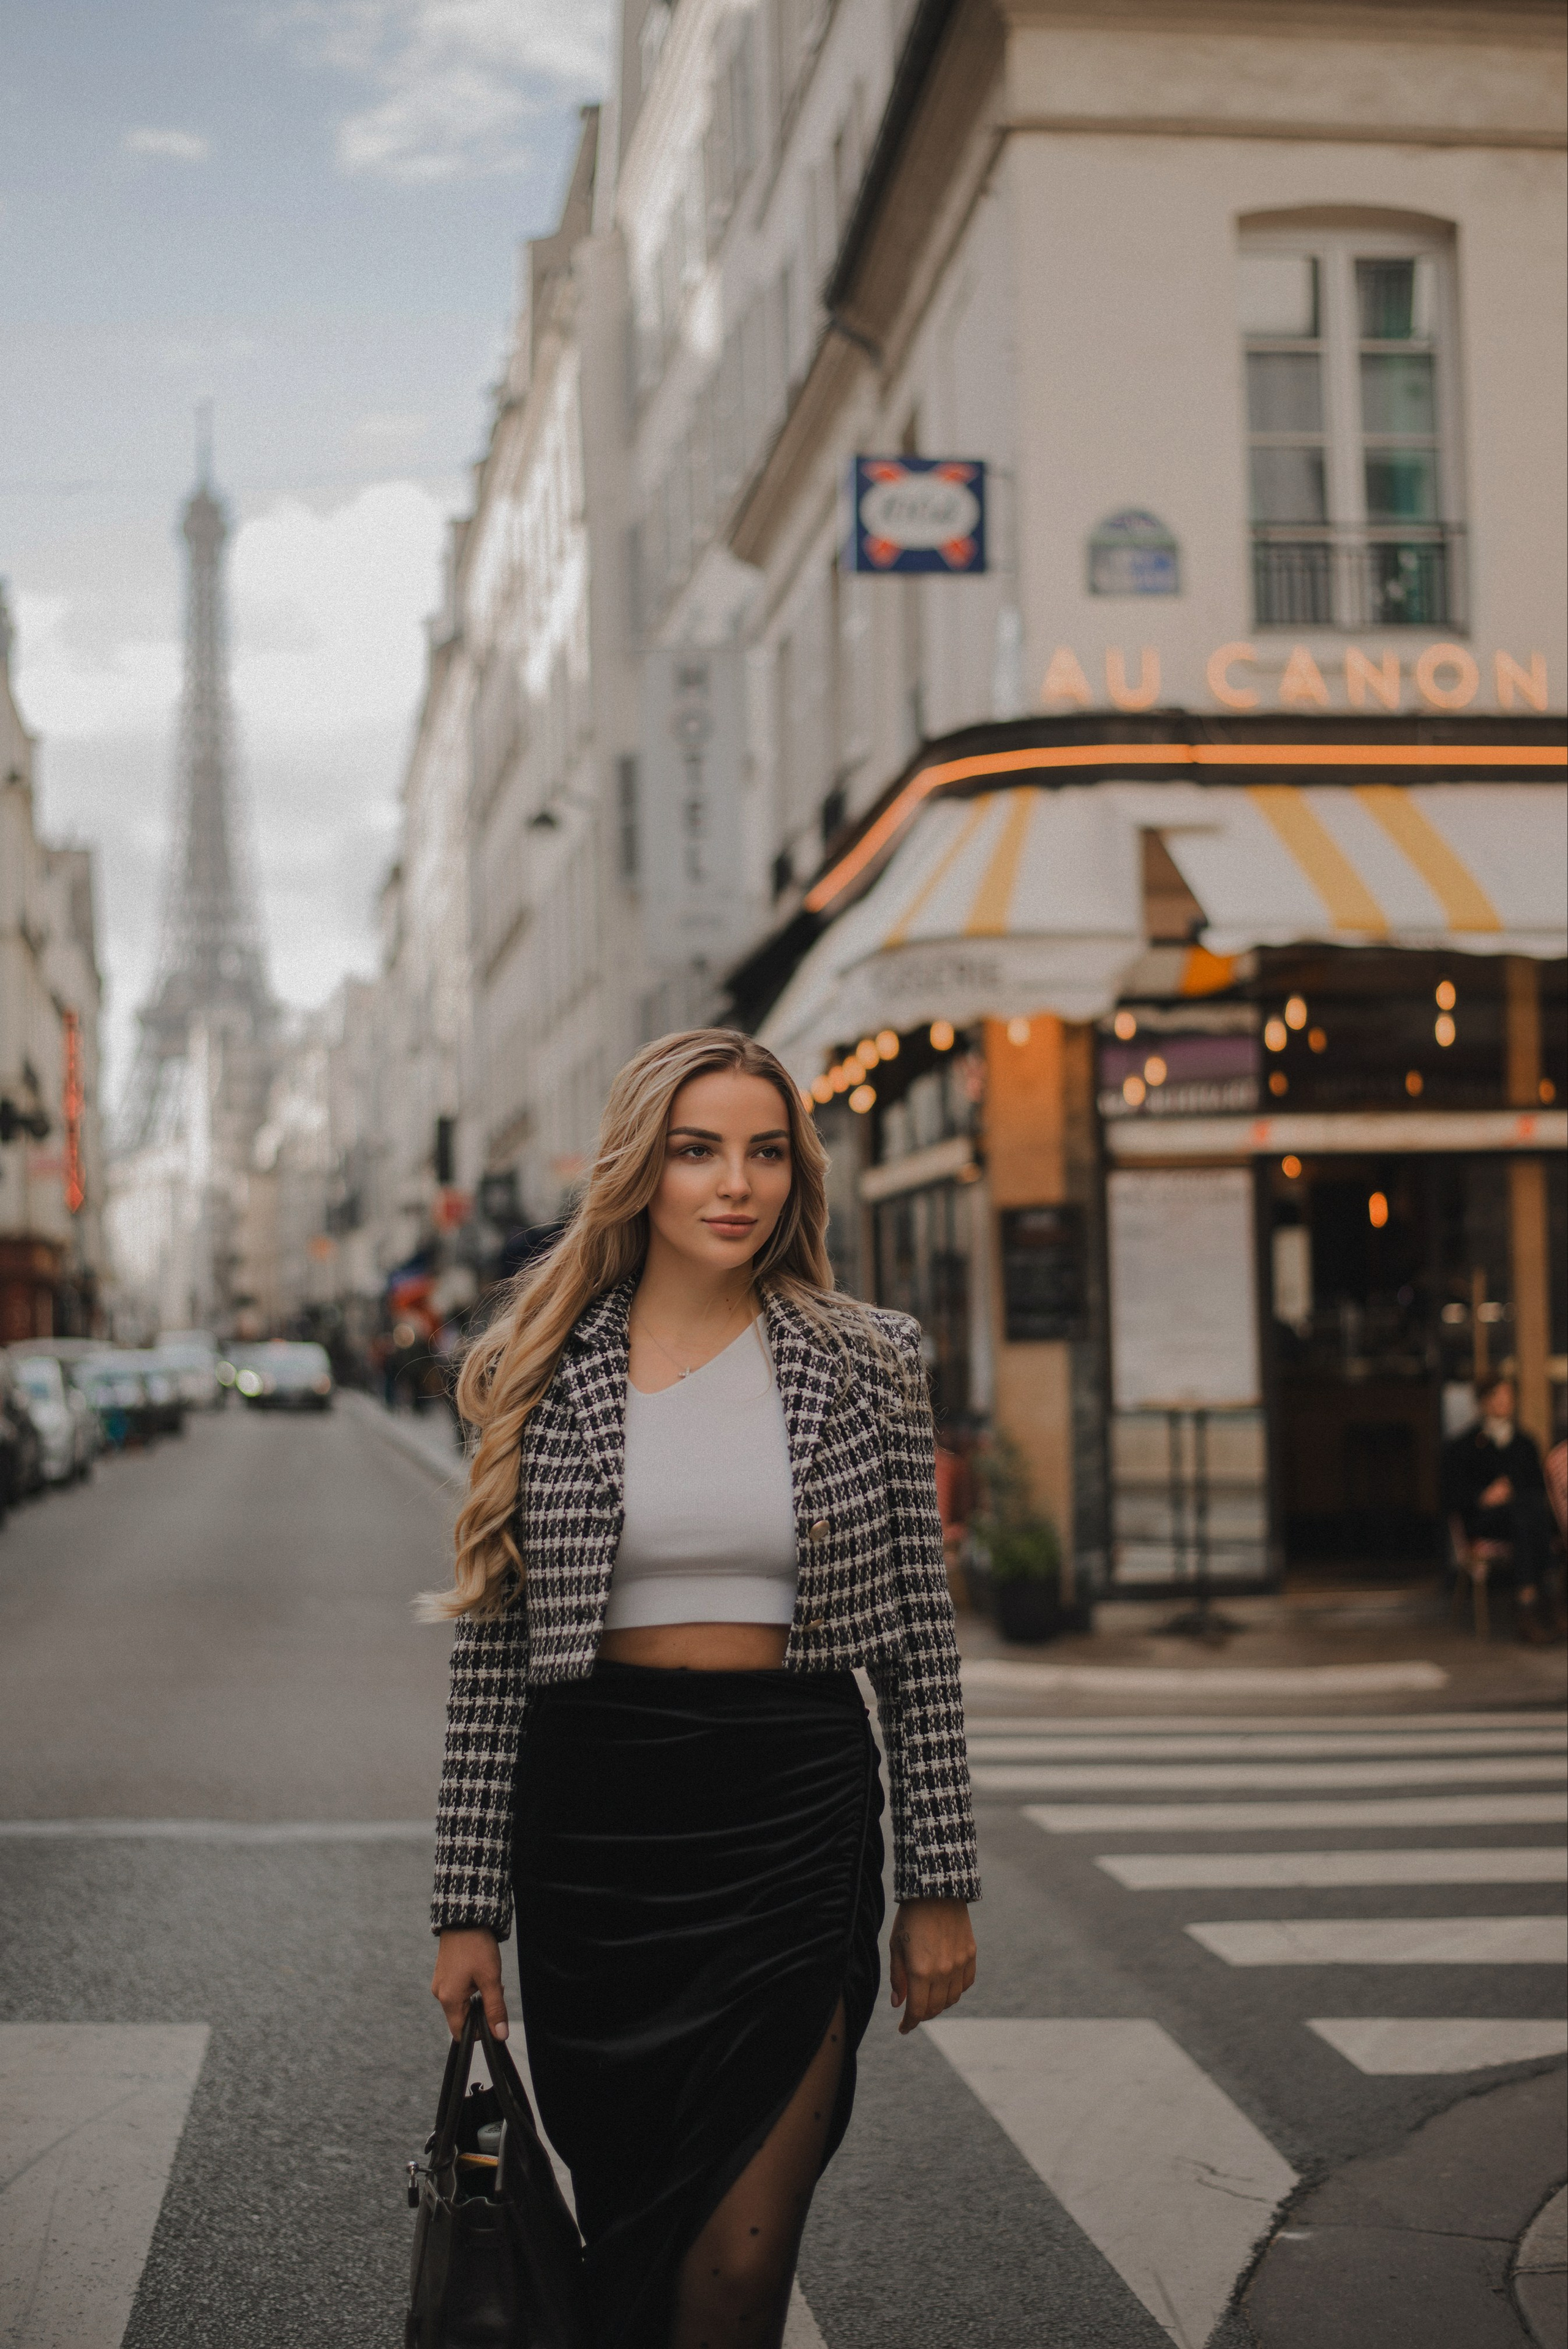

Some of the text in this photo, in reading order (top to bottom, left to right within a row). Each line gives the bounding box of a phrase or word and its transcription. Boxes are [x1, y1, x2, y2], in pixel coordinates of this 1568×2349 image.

[1040, 641, 1549, 713] AU CANON
[671, 660, 714, 886] HOTEL
